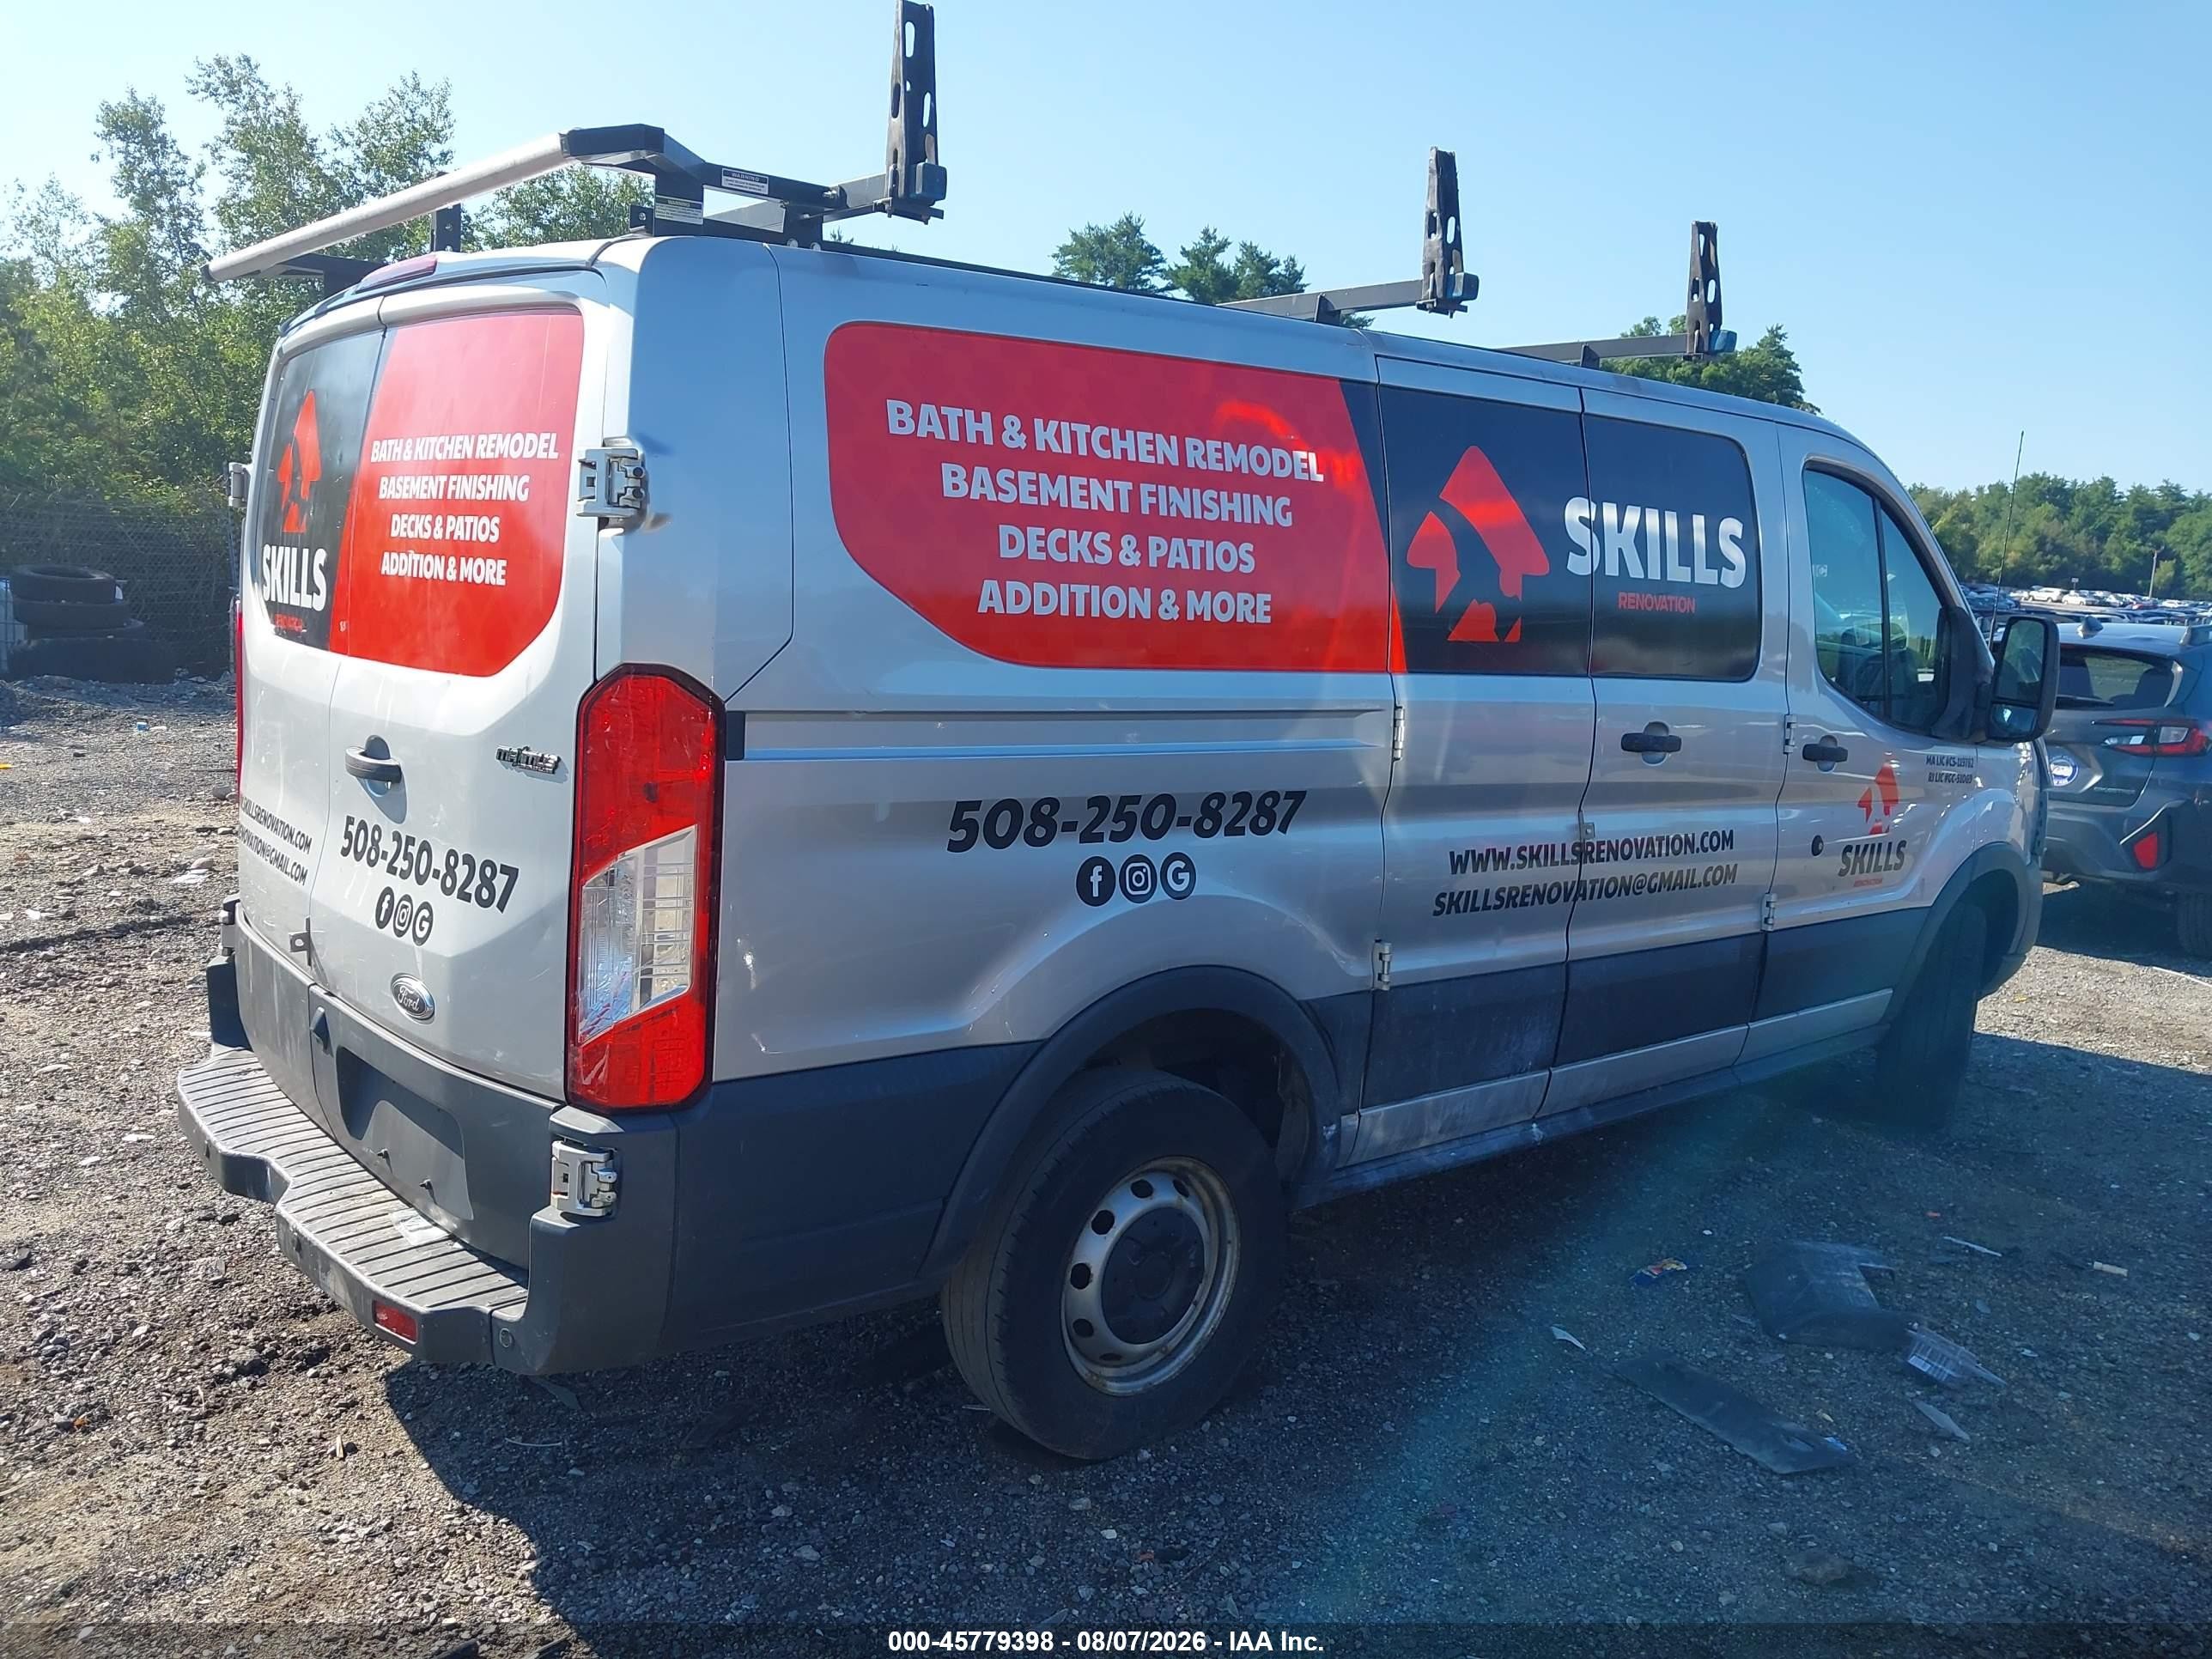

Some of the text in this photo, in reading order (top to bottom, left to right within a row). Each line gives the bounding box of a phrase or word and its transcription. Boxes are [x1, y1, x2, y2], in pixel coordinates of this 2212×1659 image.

[371, 433, 559, 463] BATH & KITCHEN REMODEL
[886, 399, 1324, 483] BATH & KITCHEN REMODEL
[379, 475, 530, 502] BASEMENT FINISHING
[941, 462, 1293, 527] BASEMENT FINISHING
[391, 515, 501, 543] DECKS & PATIOS
[999, 525, 1255, 573] DECKS & PATIOS
[1564, 496, 1747, 589] SKILLS
[262, 544, 326, 611] SKILLS
[380, 550, 507, 586] ADDITION & MORE
[978, 580, 1272, 623] ADDITION & MORE
[1618, 592, 1696, 613] RENOVATION
[946, 790, 1307, 854] 508-250-8287
[340, 815, 520, 915] 508-250-8287
[1449, 830, 1734, 875] WWW.SKILLSRENOVATION.COM
[1838, 840, 1907, 878] SKILLS
[1432, 863, 1738, 917] SKILLSRENOVATION@GMAIL.COM
[398, 985, 420, 1012] Ford
